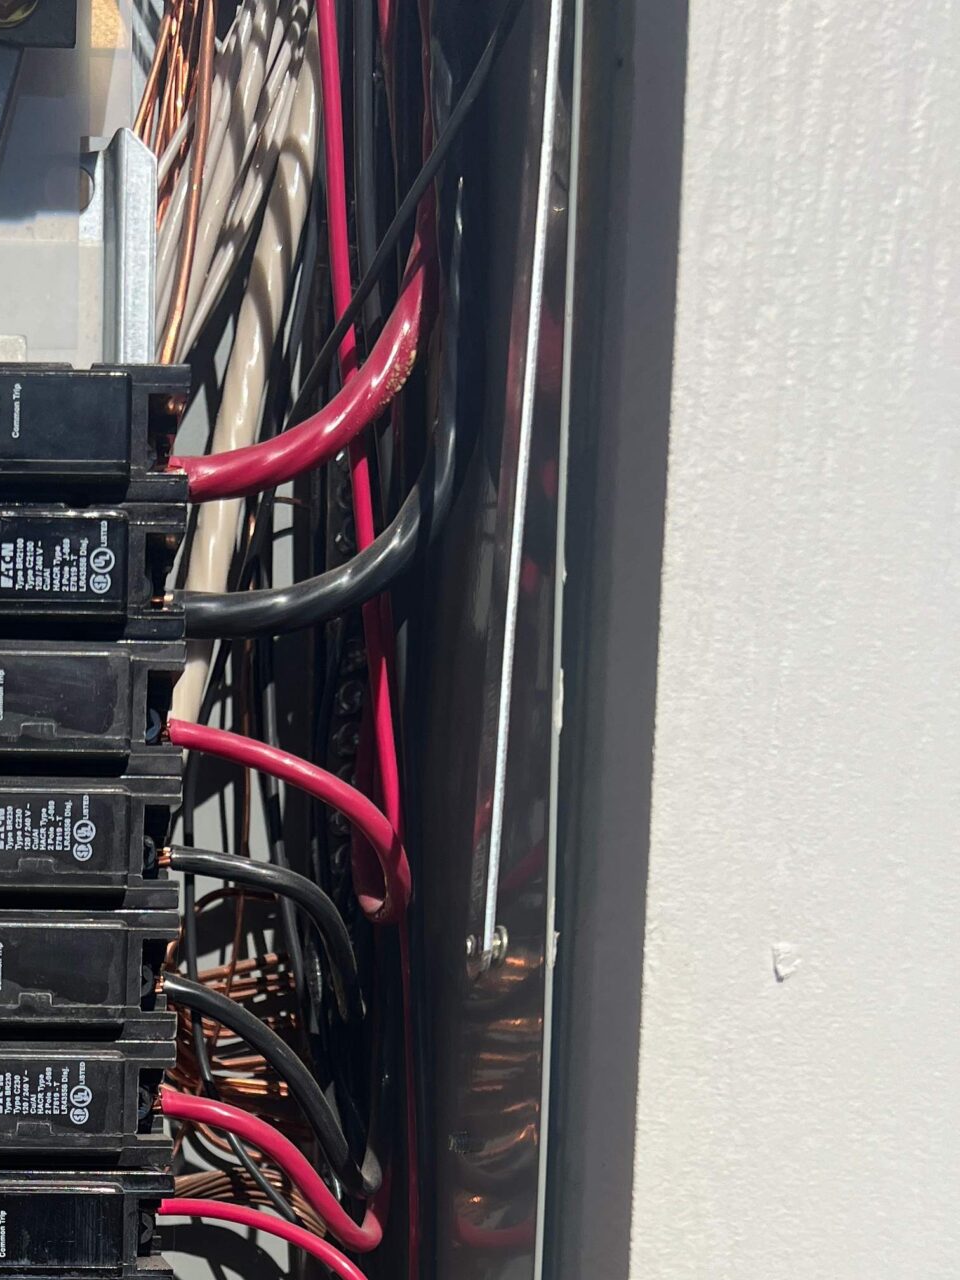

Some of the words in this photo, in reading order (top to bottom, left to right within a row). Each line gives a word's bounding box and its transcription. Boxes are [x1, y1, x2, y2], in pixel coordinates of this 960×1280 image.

[12, 384, 21, 402] Trip
[53, 546, 62, 565] Type
[16, 570, 24, 590] Type
[26, 571, 34, 590] Type
[6, 831, 14, 850] Type
[15, 831, 24, 850] Type
